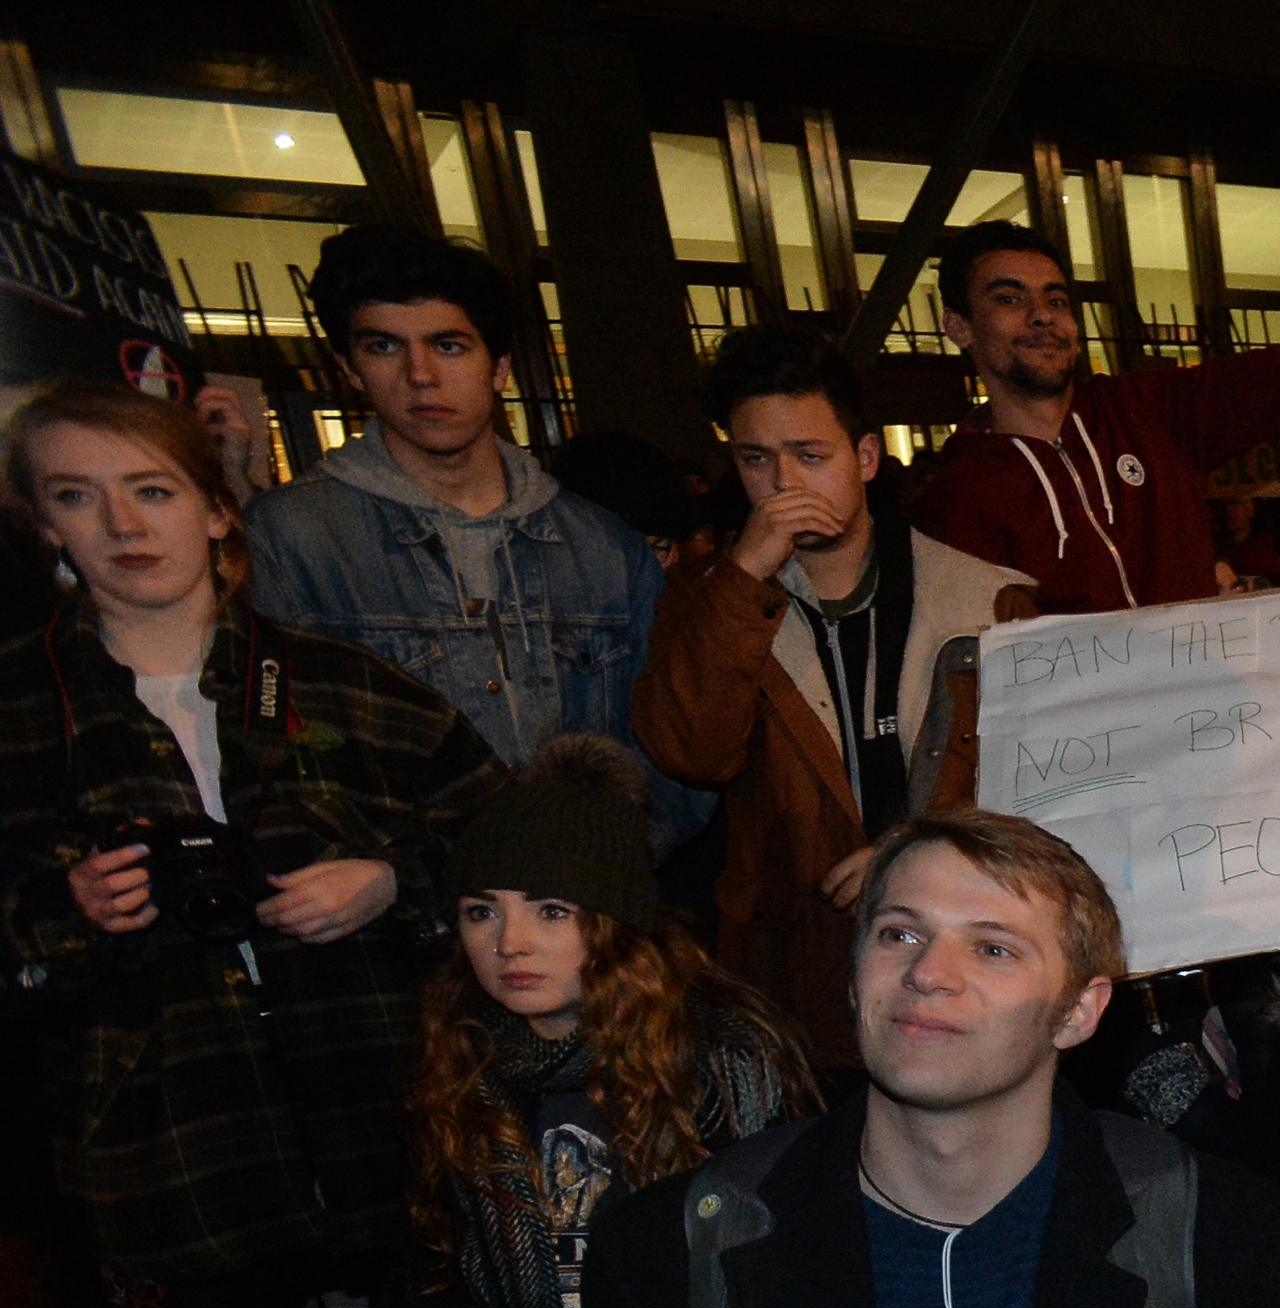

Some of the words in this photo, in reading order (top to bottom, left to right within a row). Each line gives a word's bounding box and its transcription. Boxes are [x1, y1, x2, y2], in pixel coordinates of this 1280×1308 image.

[999, 627, 1133, 688] BAN
[1154, 617, 1256, 668] THE
[259, 658, 281, 718] Canon
[1014, 724, 1143, 792] NOT
